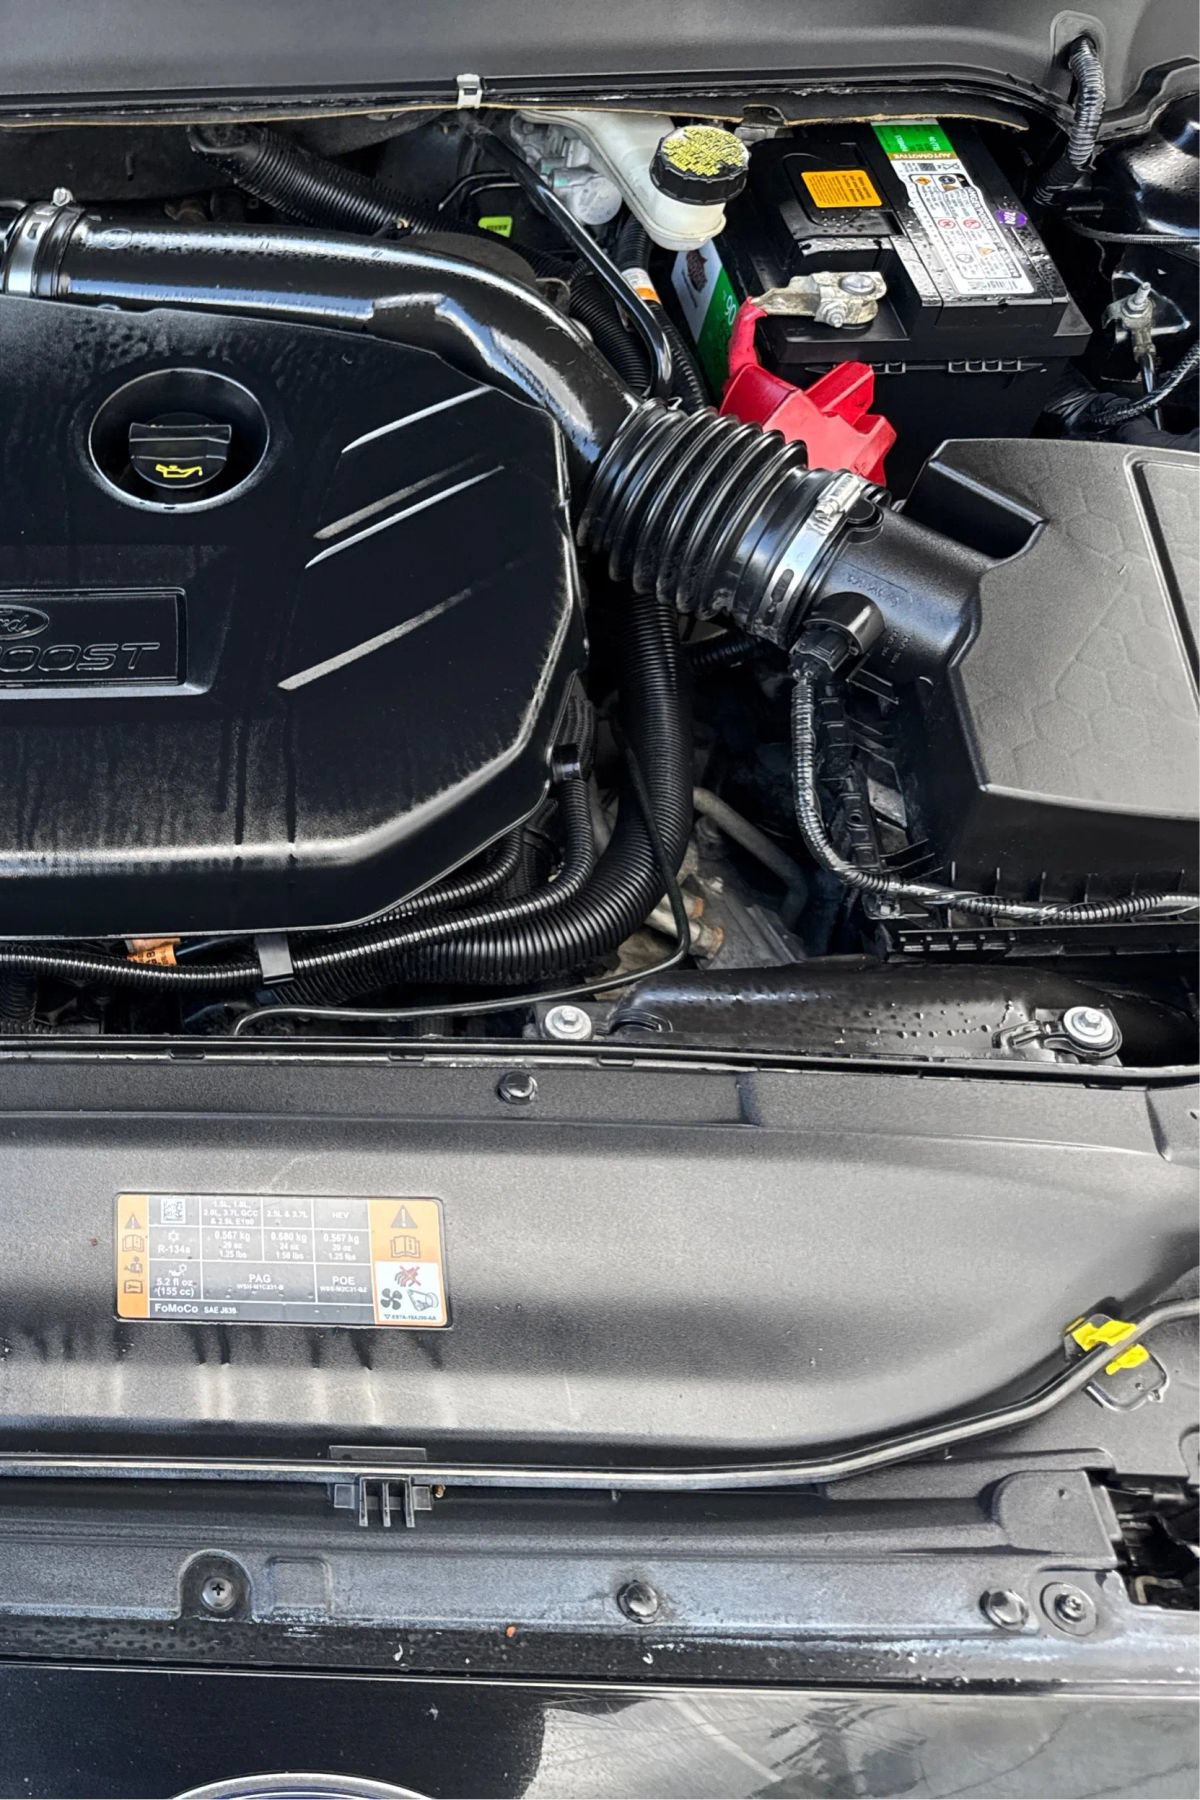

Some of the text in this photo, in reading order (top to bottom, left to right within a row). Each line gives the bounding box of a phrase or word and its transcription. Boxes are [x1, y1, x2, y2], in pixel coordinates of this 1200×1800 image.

[331, 1211, 349, 1219] HEV
[239, 1231, 250, 1242] kg
[158, 1244, 191, 1254] R-134a
[292, 1251, 304, 1259] lbs
[155, 1277, 193, 1287] 5.2 fl oz
[248, 1273, 272, 1284] PAG
[332, 1276, 356, 1285] POE
[157, 1287, 195, 1297] (155 cc)
[154, 1303, 199, 1313] FoMoCo
[203, 1306, 218, 1314] SAE
